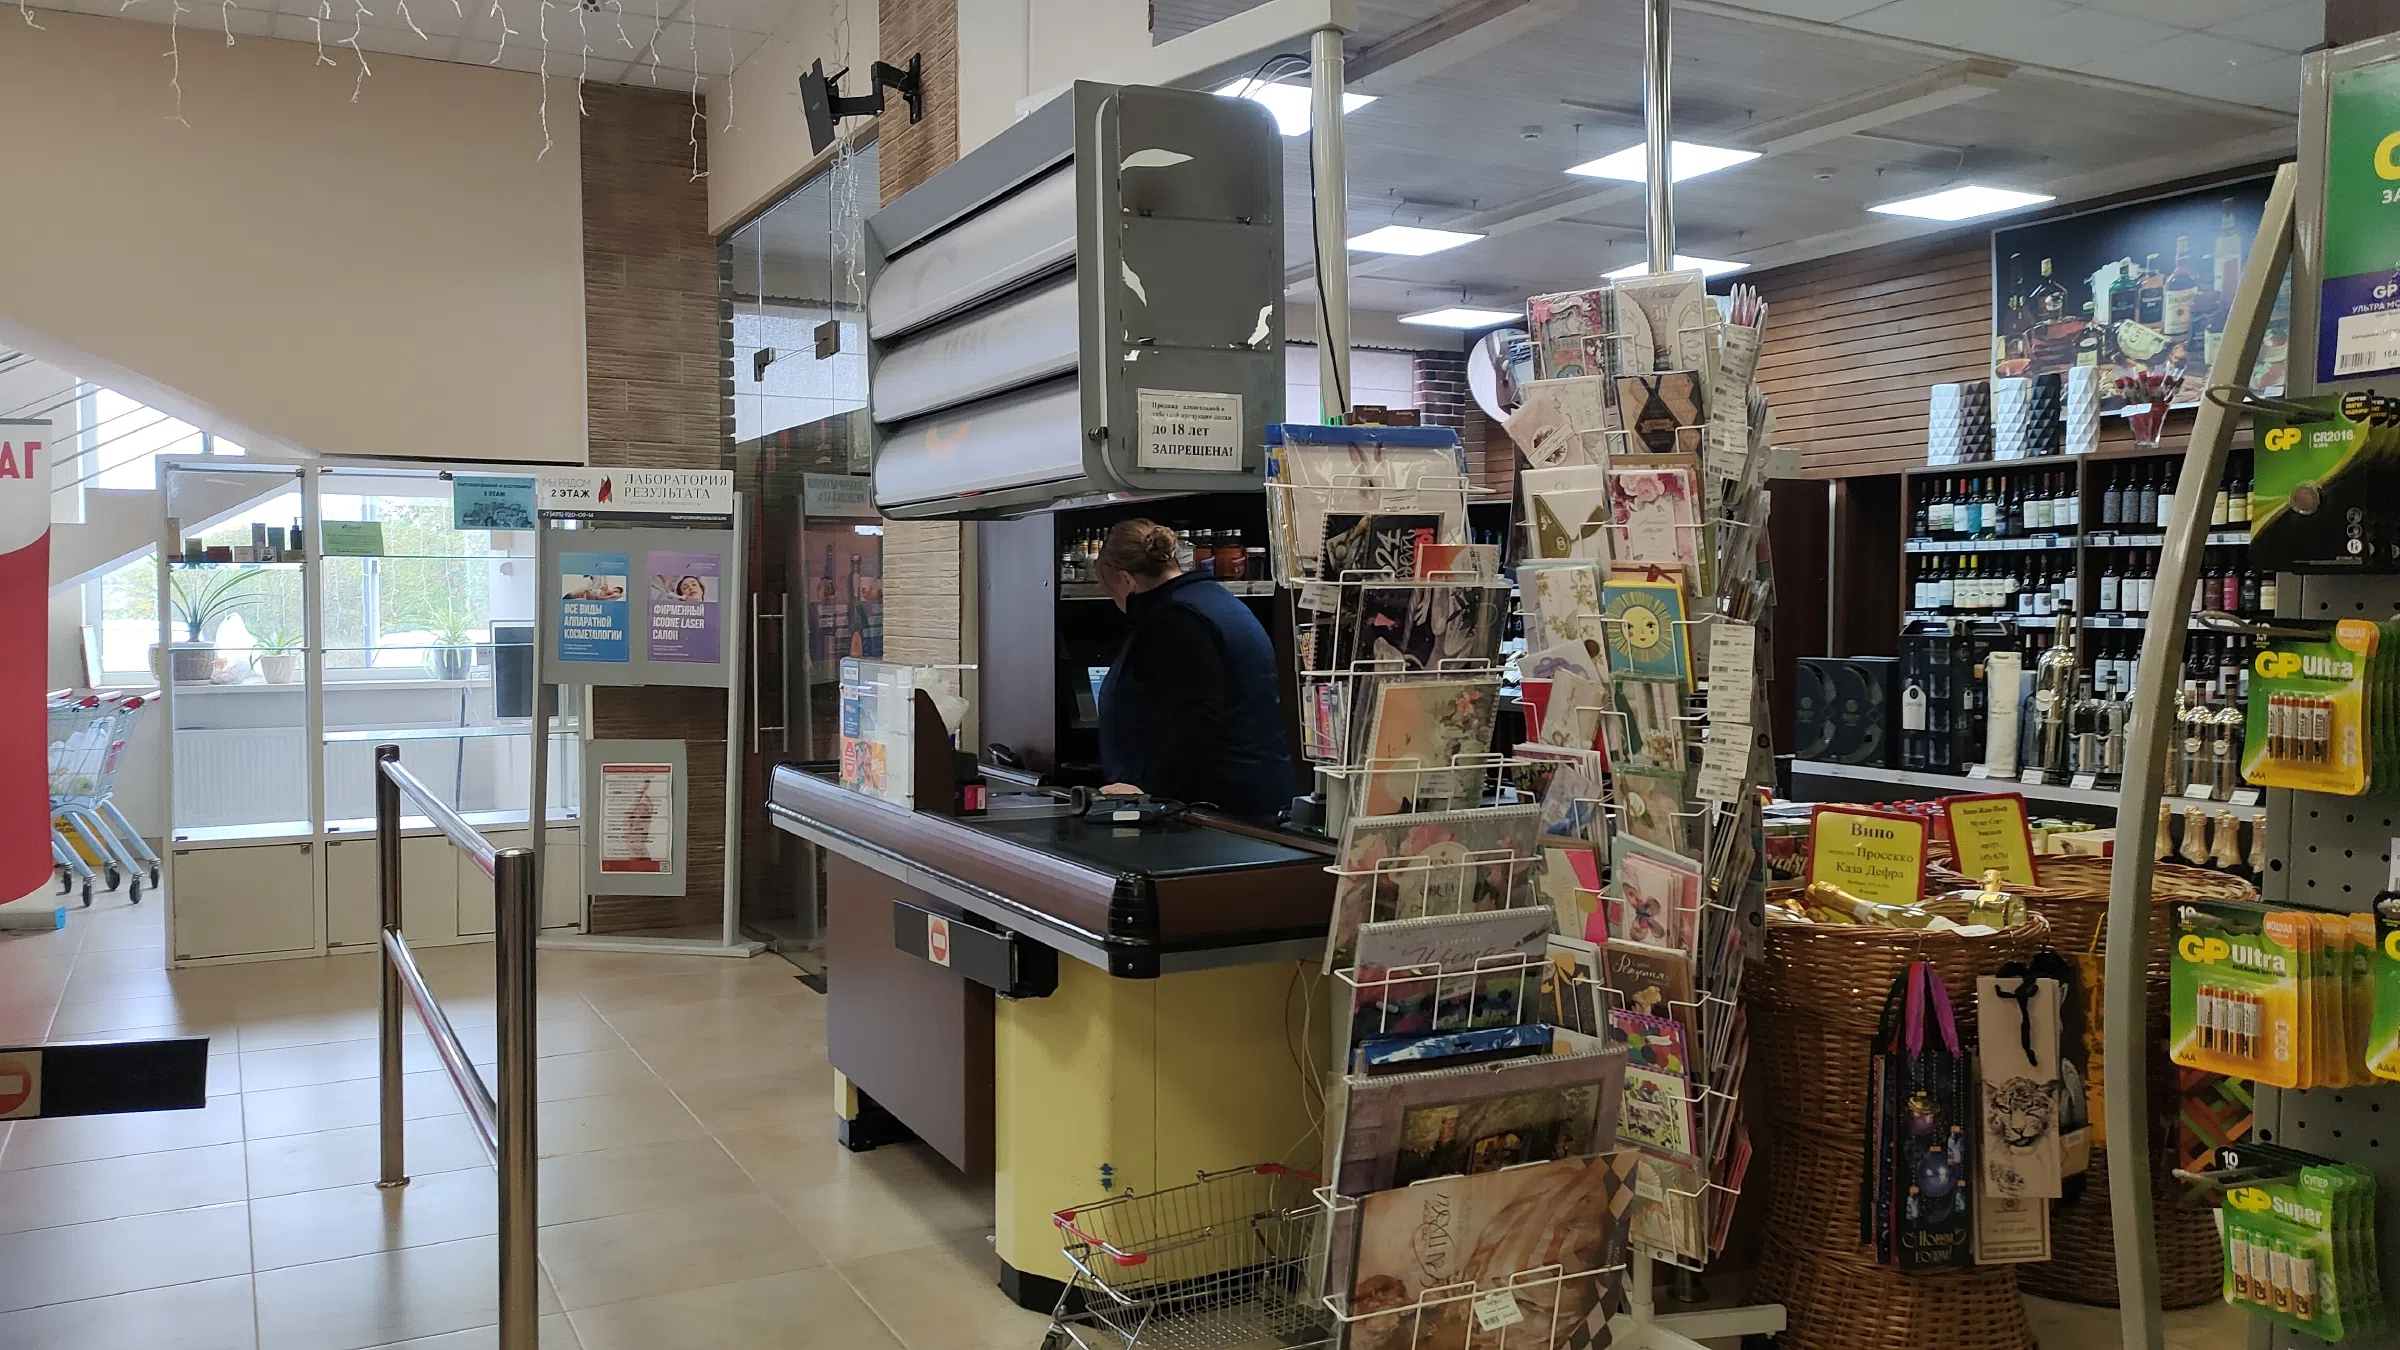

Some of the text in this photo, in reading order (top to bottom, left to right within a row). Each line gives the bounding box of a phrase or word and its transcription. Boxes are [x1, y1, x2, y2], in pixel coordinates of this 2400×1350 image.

[2373, 283, 2399, 299] GP
[2352, 303, 2385, 314] УЛЬТРА
[1152, 423, 1210, 436] до 18 лет
[2265, 428, 2302, 452] GP
[2313, 430, 2354, 443] CR2016
[1152, 444, 1233, 457] ЗАПРЕЩЕНА!
[542, 478, 592, 487] МЫ РЯДОМ
[624, 473, 728, 486] ЛАБОРАТОРИЯ
[551, 489, 590, 498] 2 ЭТАЖ
[624, 487, 711, 499] РЕЗУЛЬТАТА
[564, 604, 603, 615] ВСЕ ВИДЫ
[653, 603, 705, 616] ФИРМЕННЫЙ
[564, 615, 612, 627] АППАРАТНОЙ
[653, 617, 705, 629] ICOONE LASER
[564, 629, 622, 641] КОСМЕТОЛОГИИ
[652, 630, 679, 640] САЛОН
[2255, 650, 2354, 679] GP Ultra
[2250, 771, 2266, 780] AAA
[1851, 823, 1895, 840] Вино
[1856, 847, 1914, 863] Просекко
[1836, 862, 1904, 880] Каза Дефра
[2178, 934, 2286, 973] GP Ultra
[2178, 1051, 2196, 1062] AAA
[2377, 1062, 2397, 1073] AAA
[2222, 1150, 2239, 1167] 10
[2272, 1195, 2322, 1224] Super
